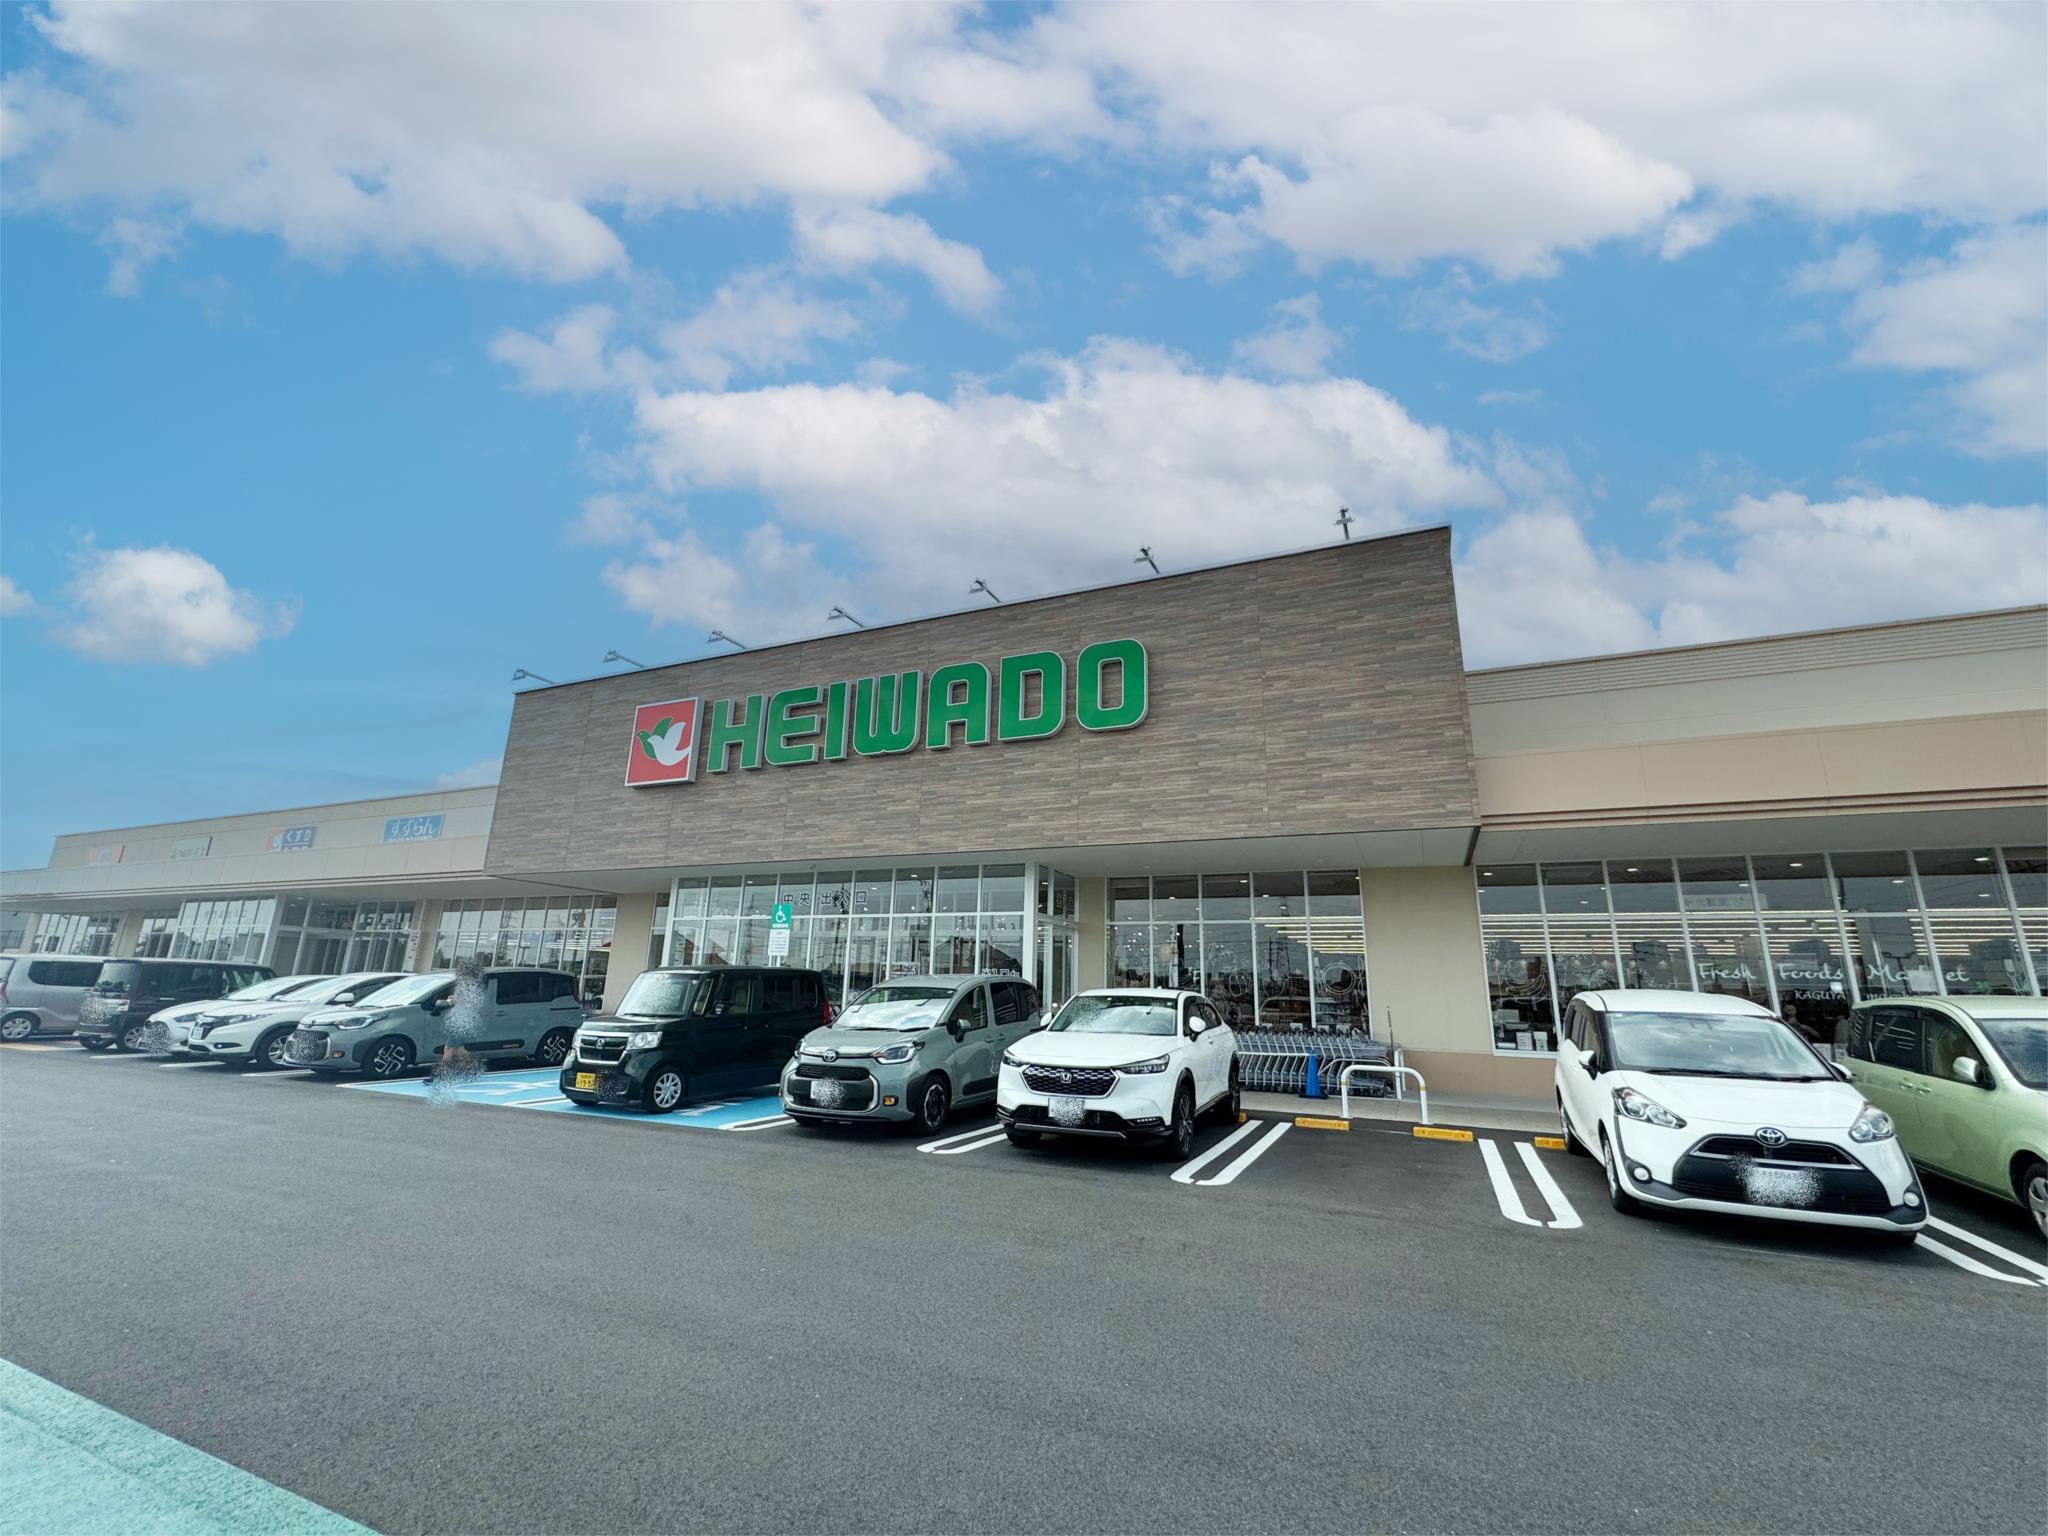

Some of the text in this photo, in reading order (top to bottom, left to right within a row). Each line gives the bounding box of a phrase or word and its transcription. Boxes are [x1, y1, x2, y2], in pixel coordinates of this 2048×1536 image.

[706, 638, 1149, 774] HEIWADO
[286, 829, 312, 842] くすり
[391, 817, 434, 837] すずらん
[1697, 962, 1757, 980] Fresh
[1776, 962, 1844, 980] Foods
[1795, 990, 1847, 1001] KAGUYA
